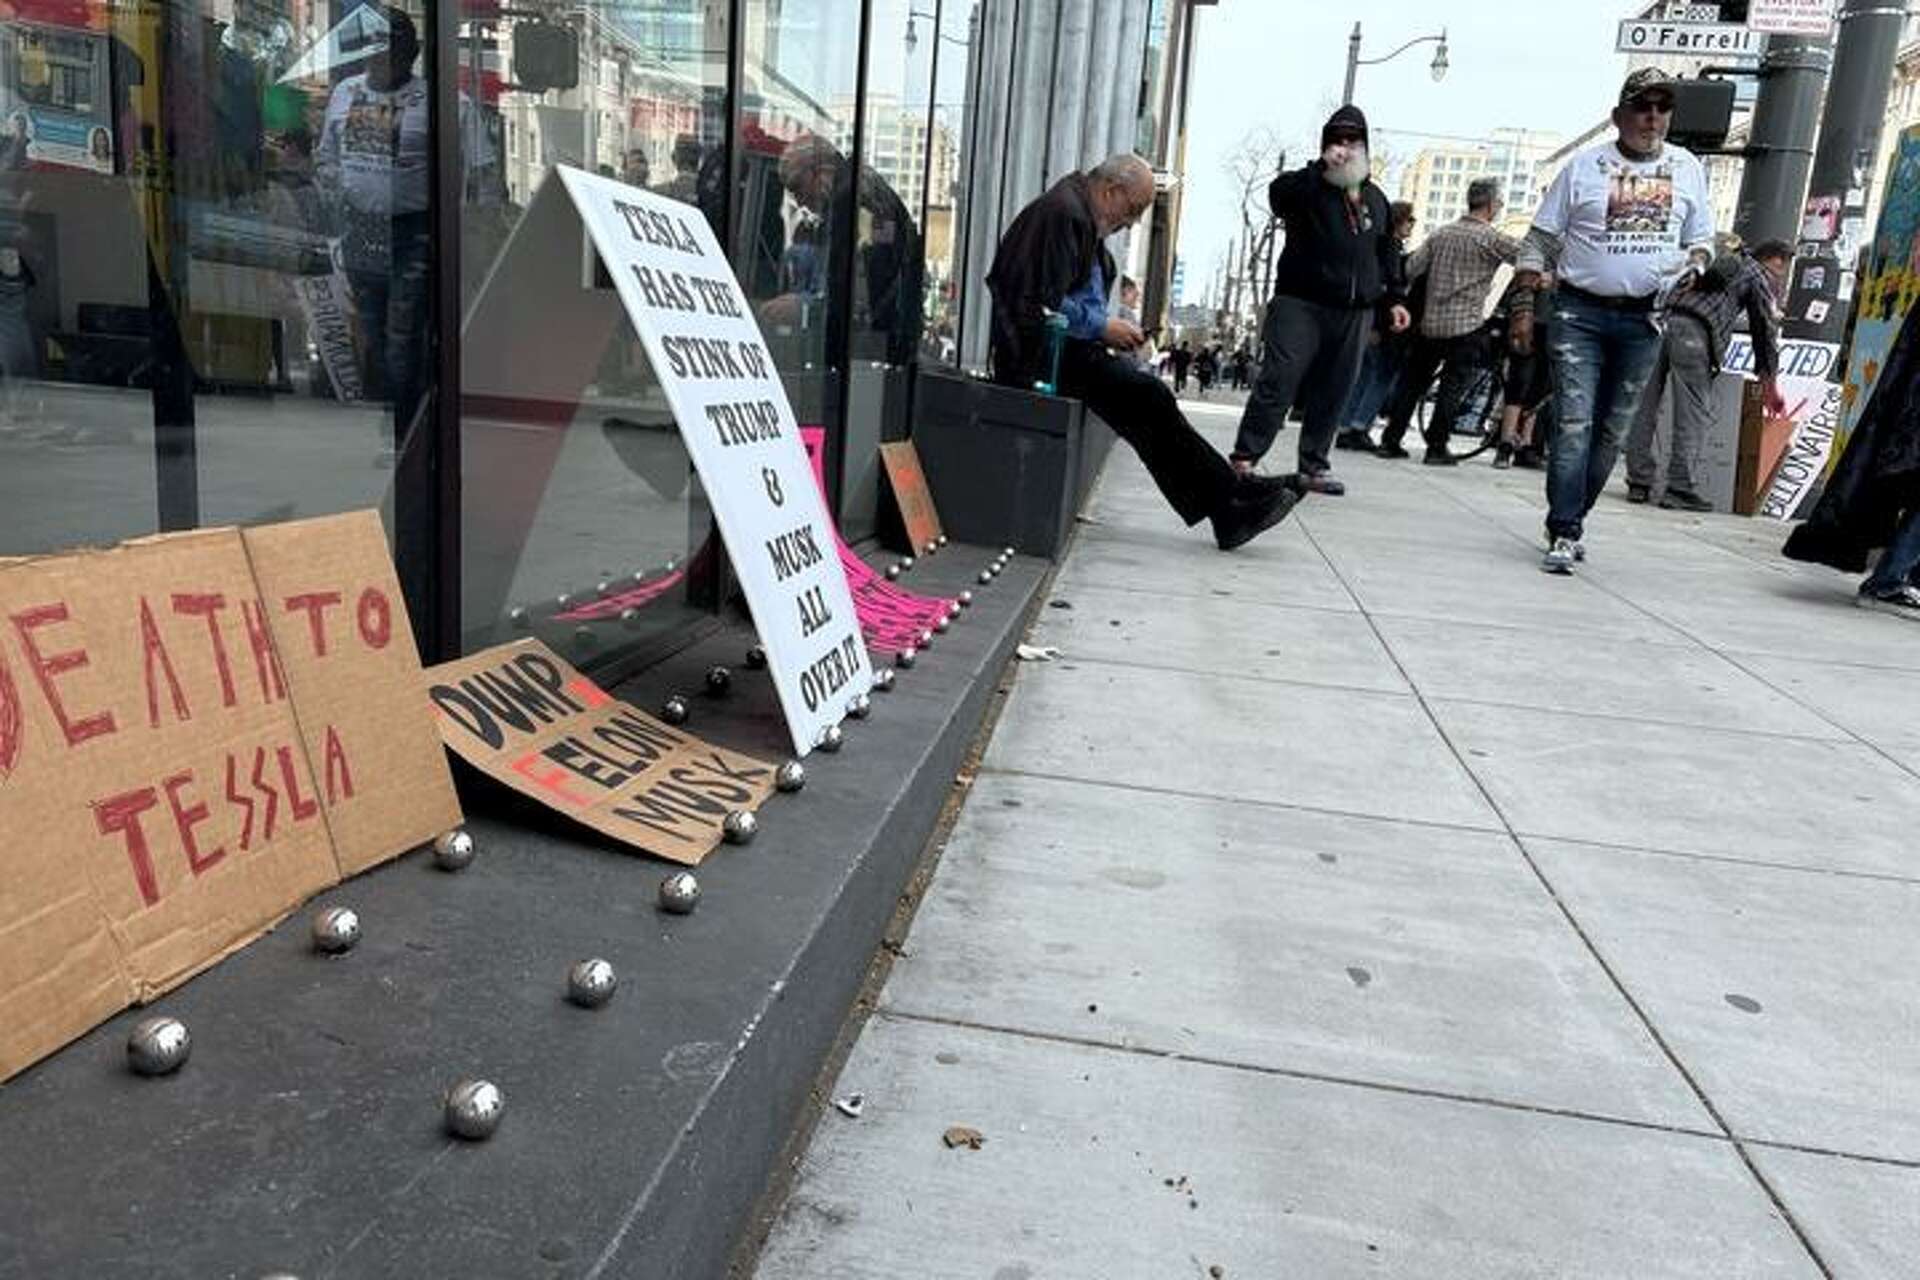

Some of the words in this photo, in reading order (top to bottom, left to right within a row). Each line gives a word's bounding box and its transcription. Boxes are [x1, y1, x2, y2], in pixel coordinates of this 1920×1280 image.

[1631, 27, 1750, 48] O'Farrell
[613, 200, 705, 256] TESLA
[631, 264, 696, 313] HAS
[691, 276, 743, 318] THE
[661, 335, 742, 379] STINK
[738, 342, 769, 380] OF
[705, 400, 782, 446] TRUMP
[762, 467, 784, 506] &
[766, 524, 823, 582] MUSK
[285, 587, 391, 657] TO
[797, 585, 832, 637] ALL
[800, 646, 850, 712] OVER
[842, 634, 860, 676] IT
[429, 653, 584, 750] DUMP
[90, 725, 354, 907] TESSLA
[613, 754, 770, 843] MUSK
